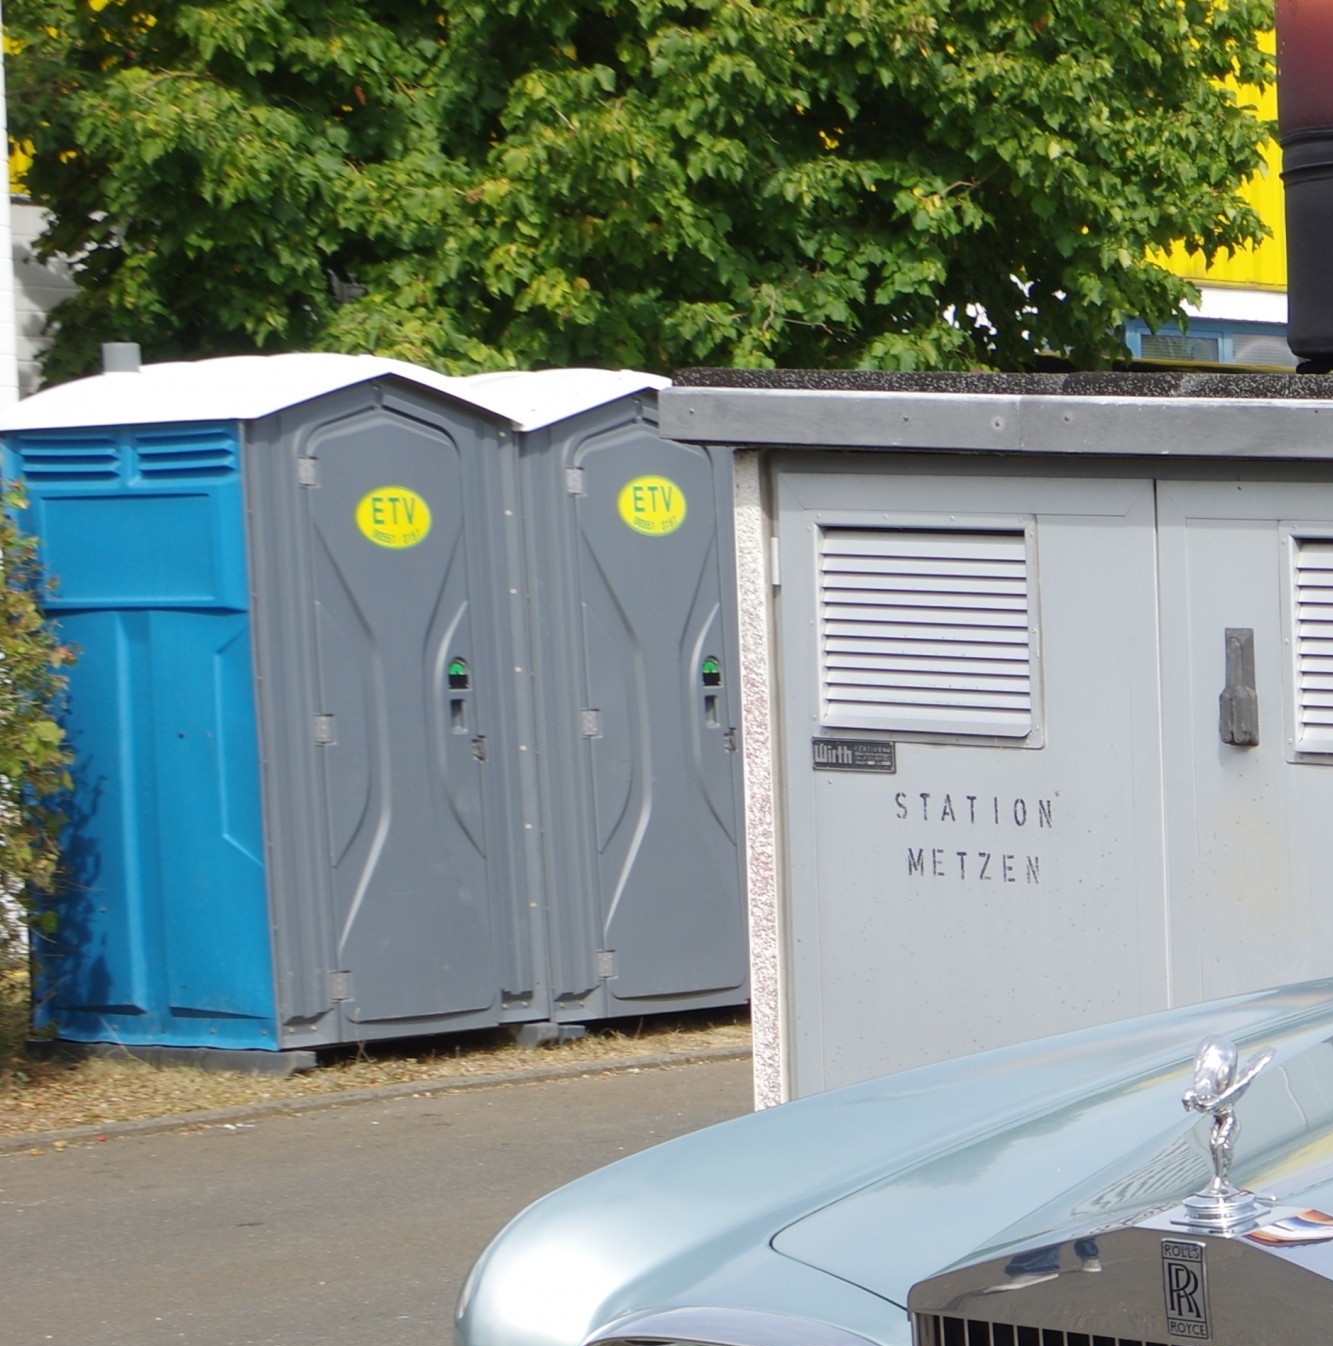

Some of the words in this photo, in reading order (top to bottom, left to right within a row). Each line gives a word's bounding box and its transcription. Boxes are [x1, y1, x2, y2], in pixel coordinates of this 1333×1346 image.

[372, 497, 415, 525] ETV
[633, 486, 672, 512] ETV
[814, 743, 854, 765] Wirth
[894, 791, 1053, 829] STATION
[907, 847, 1040, 884] METZEN
[1165, 1244, 1200, 1259] ROLLS
[1169, 1320, 1207, 1337] ROYCE
